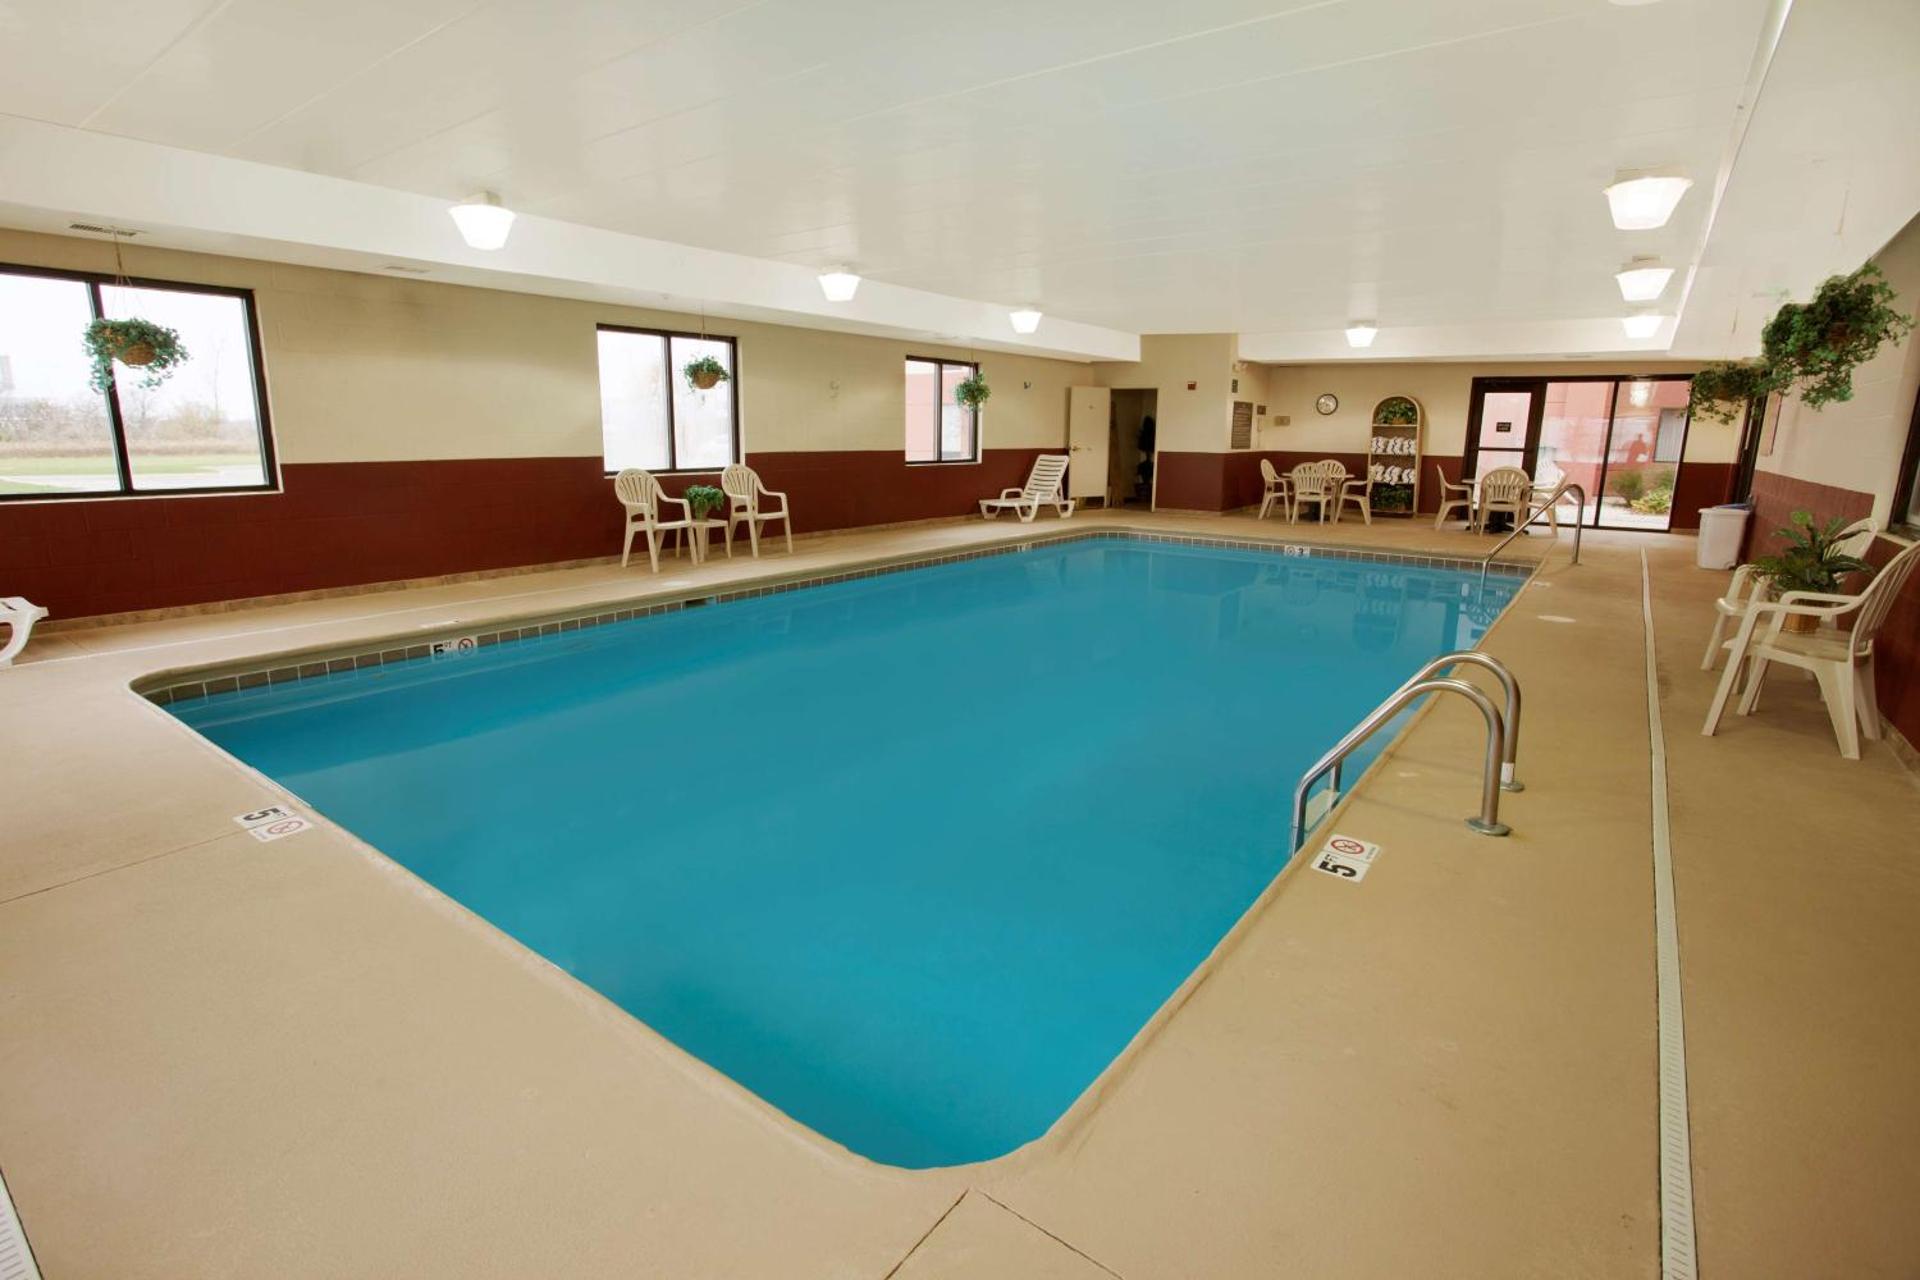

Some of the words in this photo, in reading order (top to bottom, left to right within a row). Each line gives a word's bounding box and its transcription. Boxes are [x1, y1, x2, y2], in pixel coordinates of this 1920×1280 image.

[433, 643, 444, 657] 5
[242, 807, 281, 821] 5
[1318, 860, 1357, 877] 5
